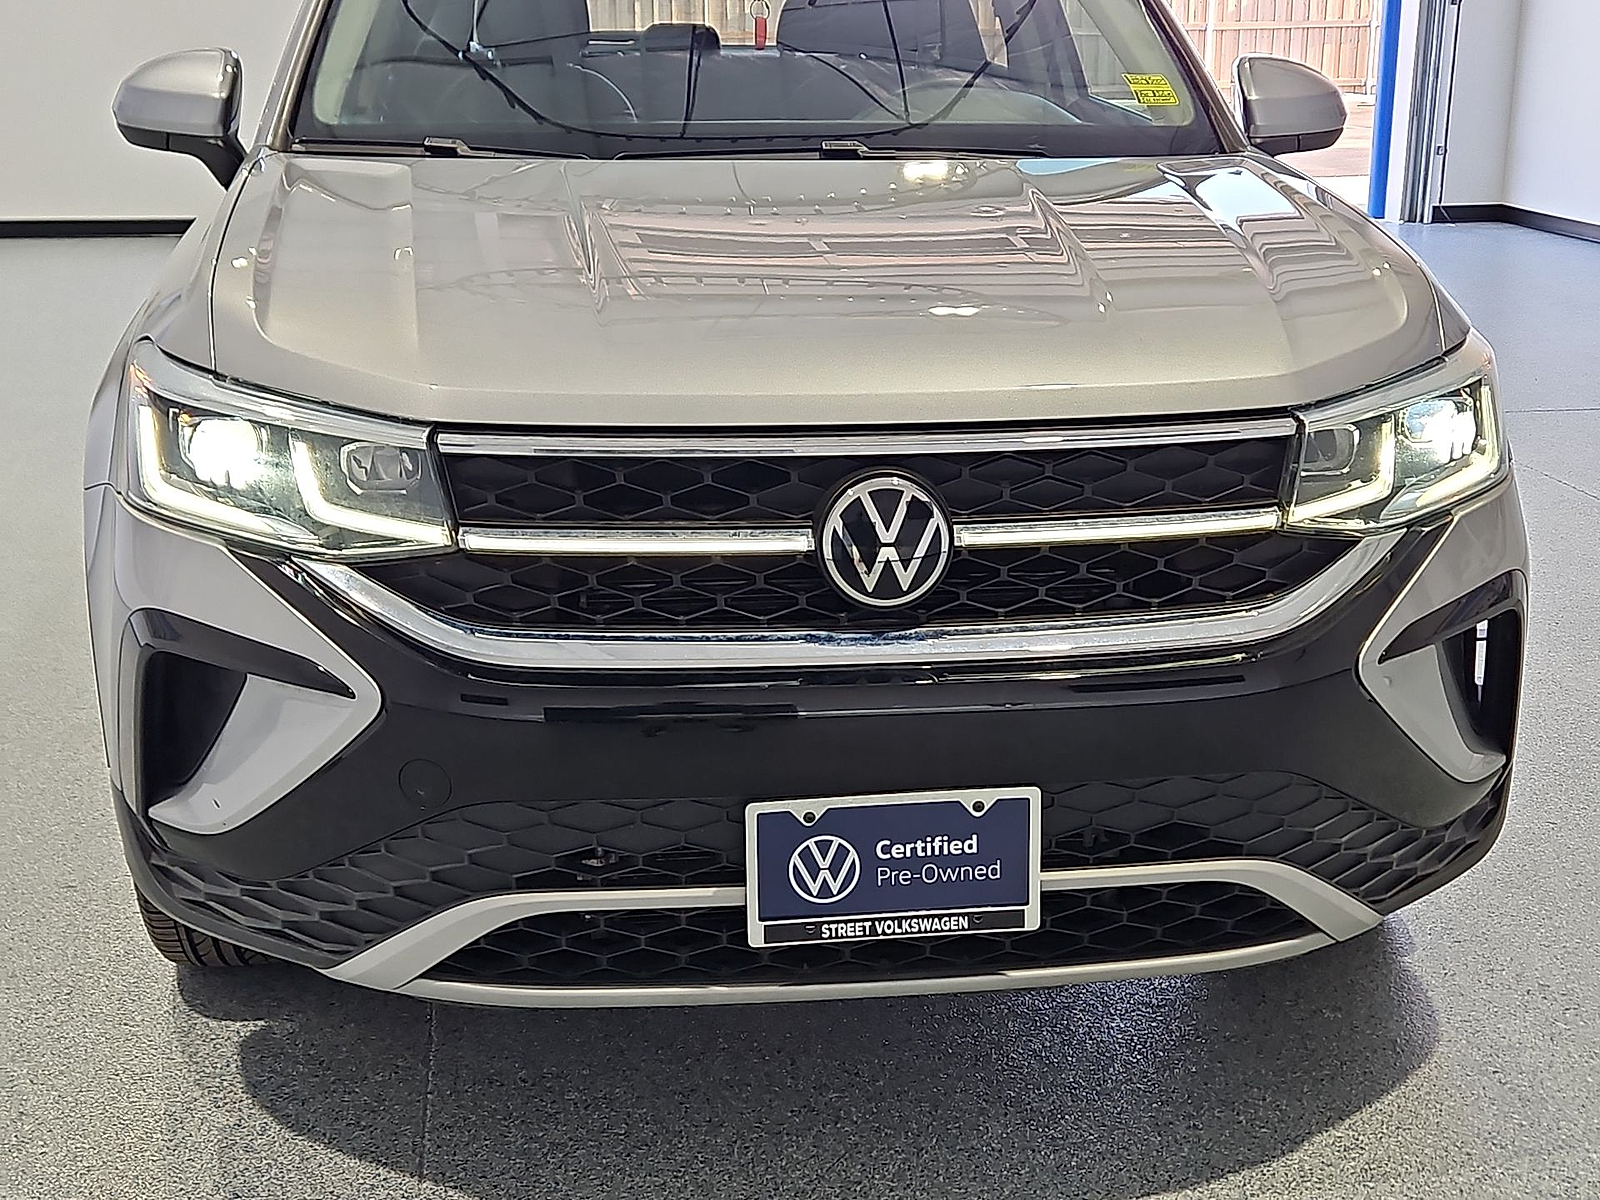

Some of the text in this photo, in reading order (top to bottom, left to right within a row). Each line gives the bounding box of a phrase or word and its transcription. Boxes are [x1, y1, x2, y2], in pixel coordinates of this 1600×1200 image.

[829, 484, 943, 594] VW
[875, 834, 978, 860] Certified
[791, 836, 858, 899] VW
[876, 860, 1001, 887] Pre-Owned
[821, 916, 969, 939] STREET VOLKSWAGEN
